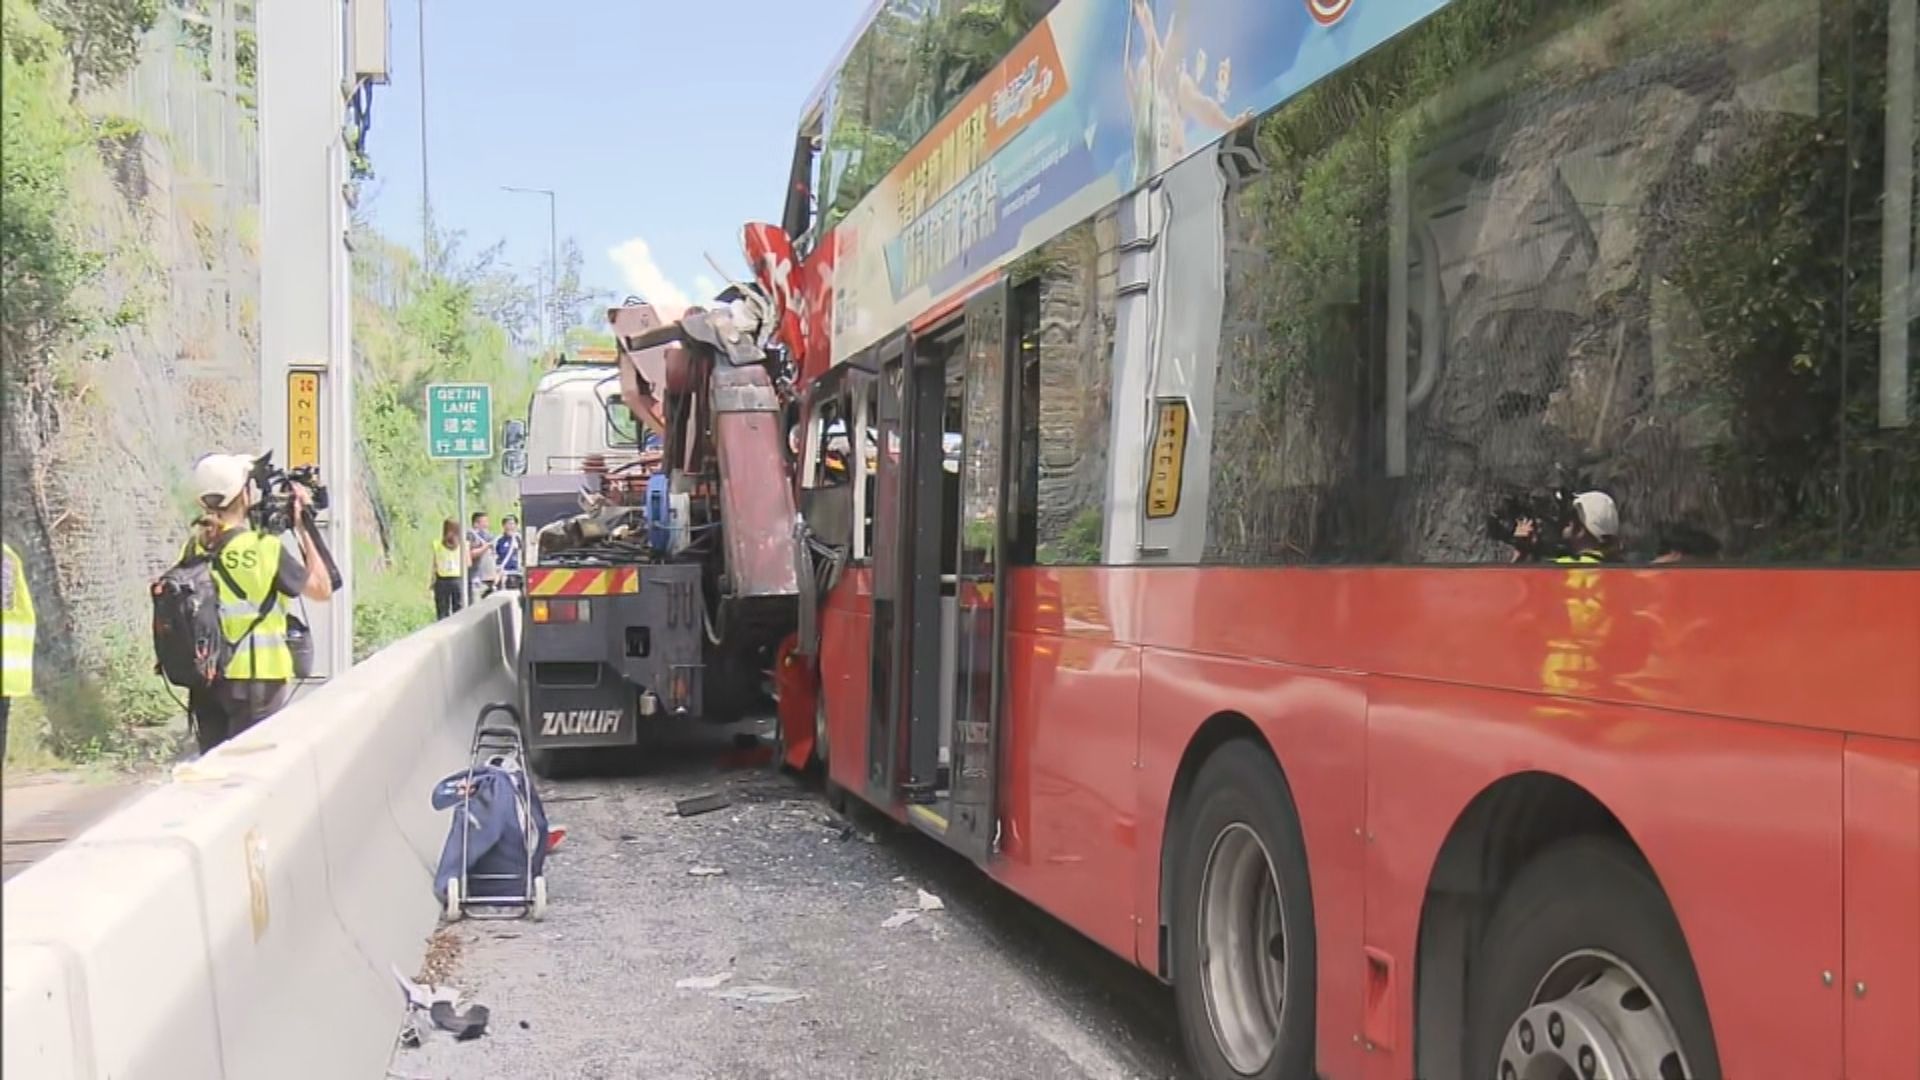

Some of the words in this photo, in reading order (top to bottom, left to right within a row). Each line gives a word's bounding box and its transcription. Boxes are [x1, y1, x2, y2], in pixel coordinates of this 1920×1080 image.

[437, 389, 464, 400] GET
[468, 389, 481, 400] IN
[443, 402, 477, 413] LANE
